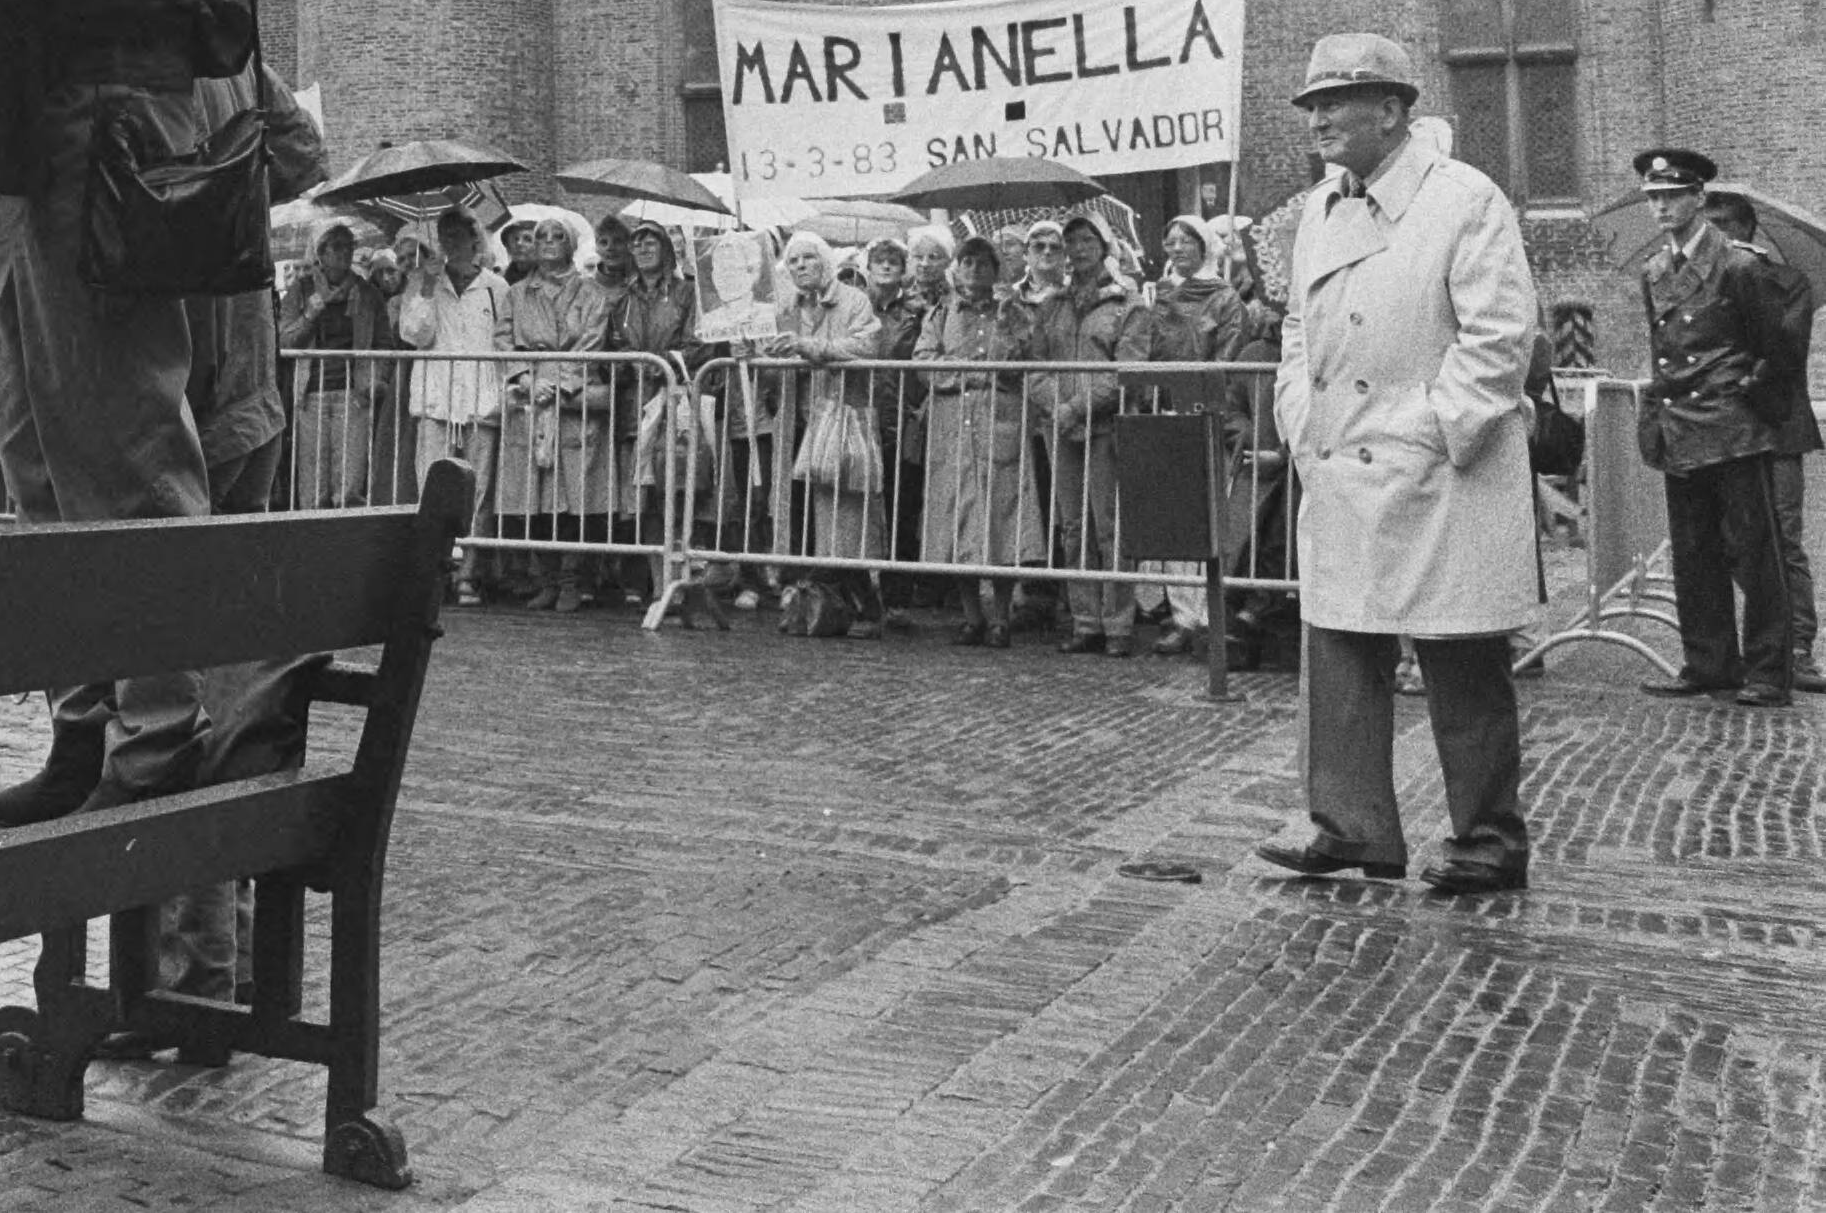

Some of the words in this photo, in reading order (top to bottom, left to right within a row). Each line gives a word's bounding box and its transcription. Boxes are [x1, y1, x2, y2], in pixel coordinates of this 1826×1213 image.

[741, 141, 897, 182] 13-3-83
[926, 131, 997, 169] SAN
[1026, 108, 1224, 158] SALVADOR
